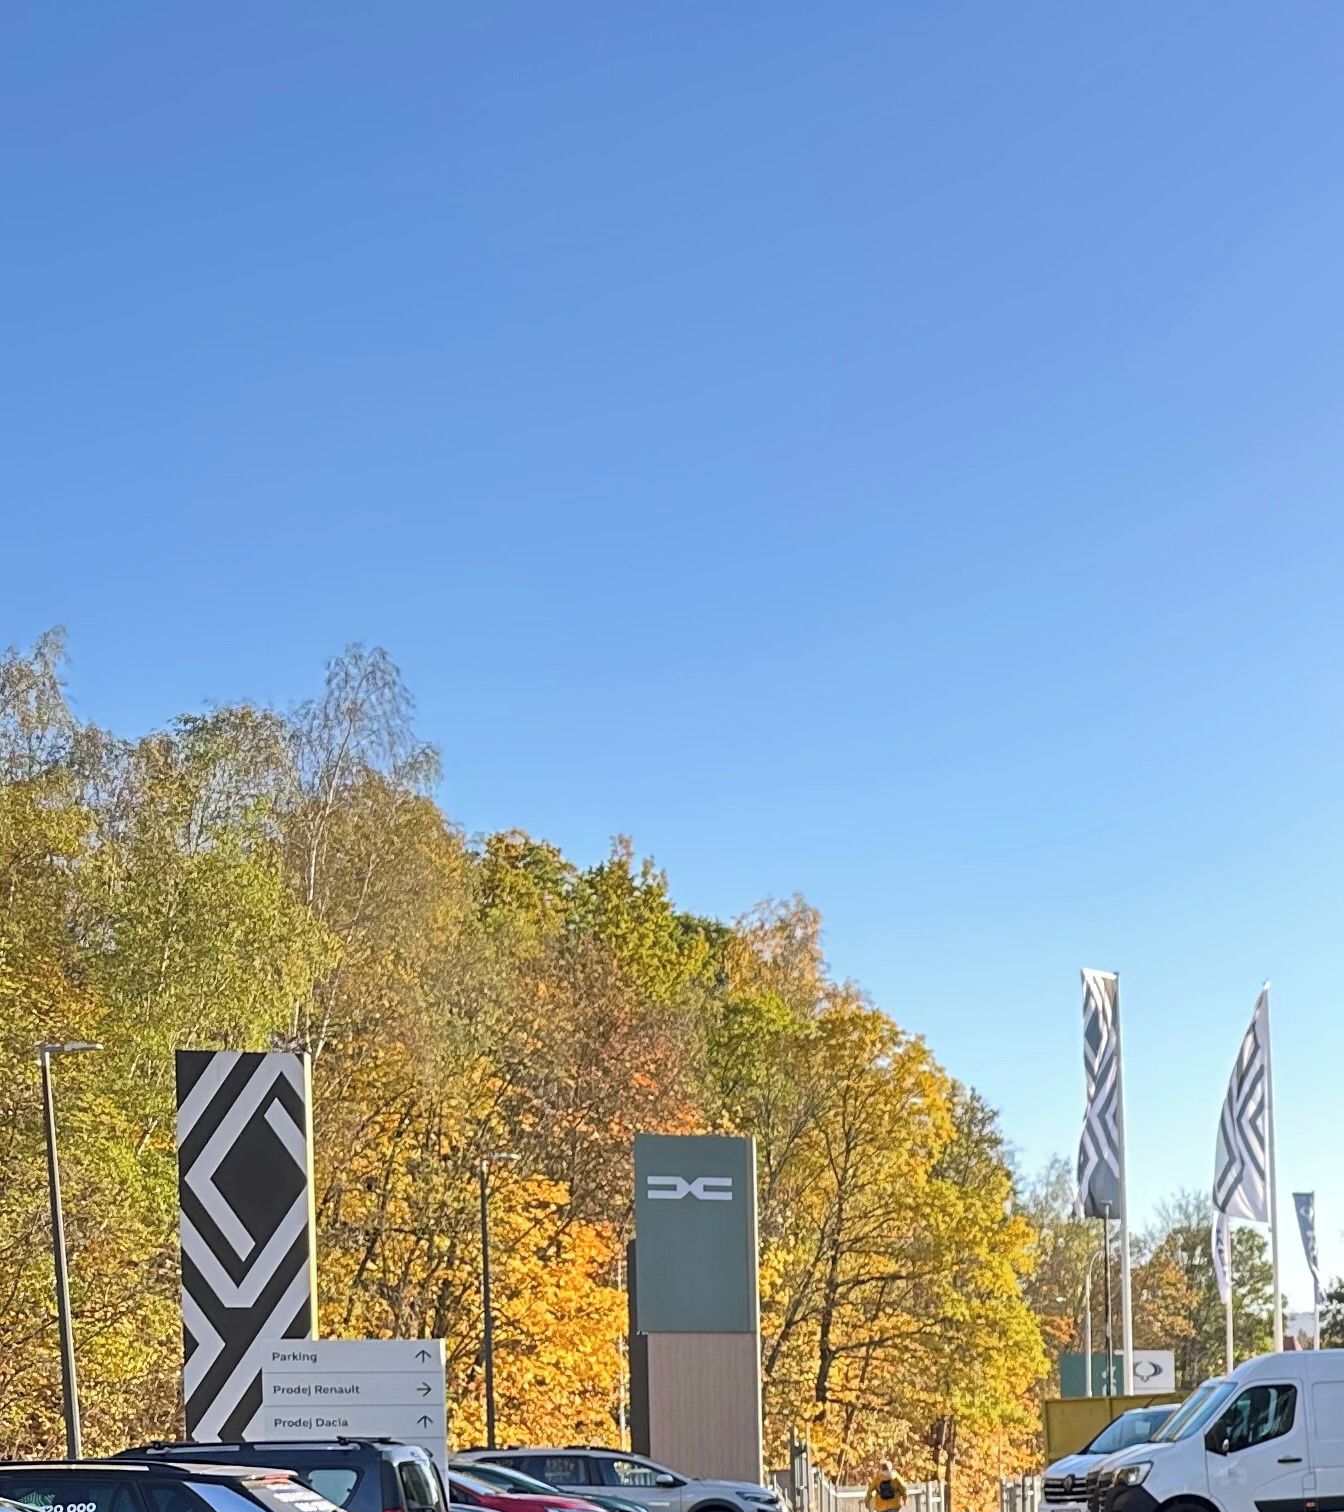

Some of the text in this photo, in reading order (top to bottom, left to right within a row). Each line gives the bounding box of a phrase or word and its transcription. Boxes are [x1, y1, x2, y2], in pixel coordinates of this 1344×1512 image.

[271, 1351, 318, 1364] Parking
[273, 1384, 360, 1397] Prodej Renault
[274, 1417, 349, 1430] Prodej Dacia
